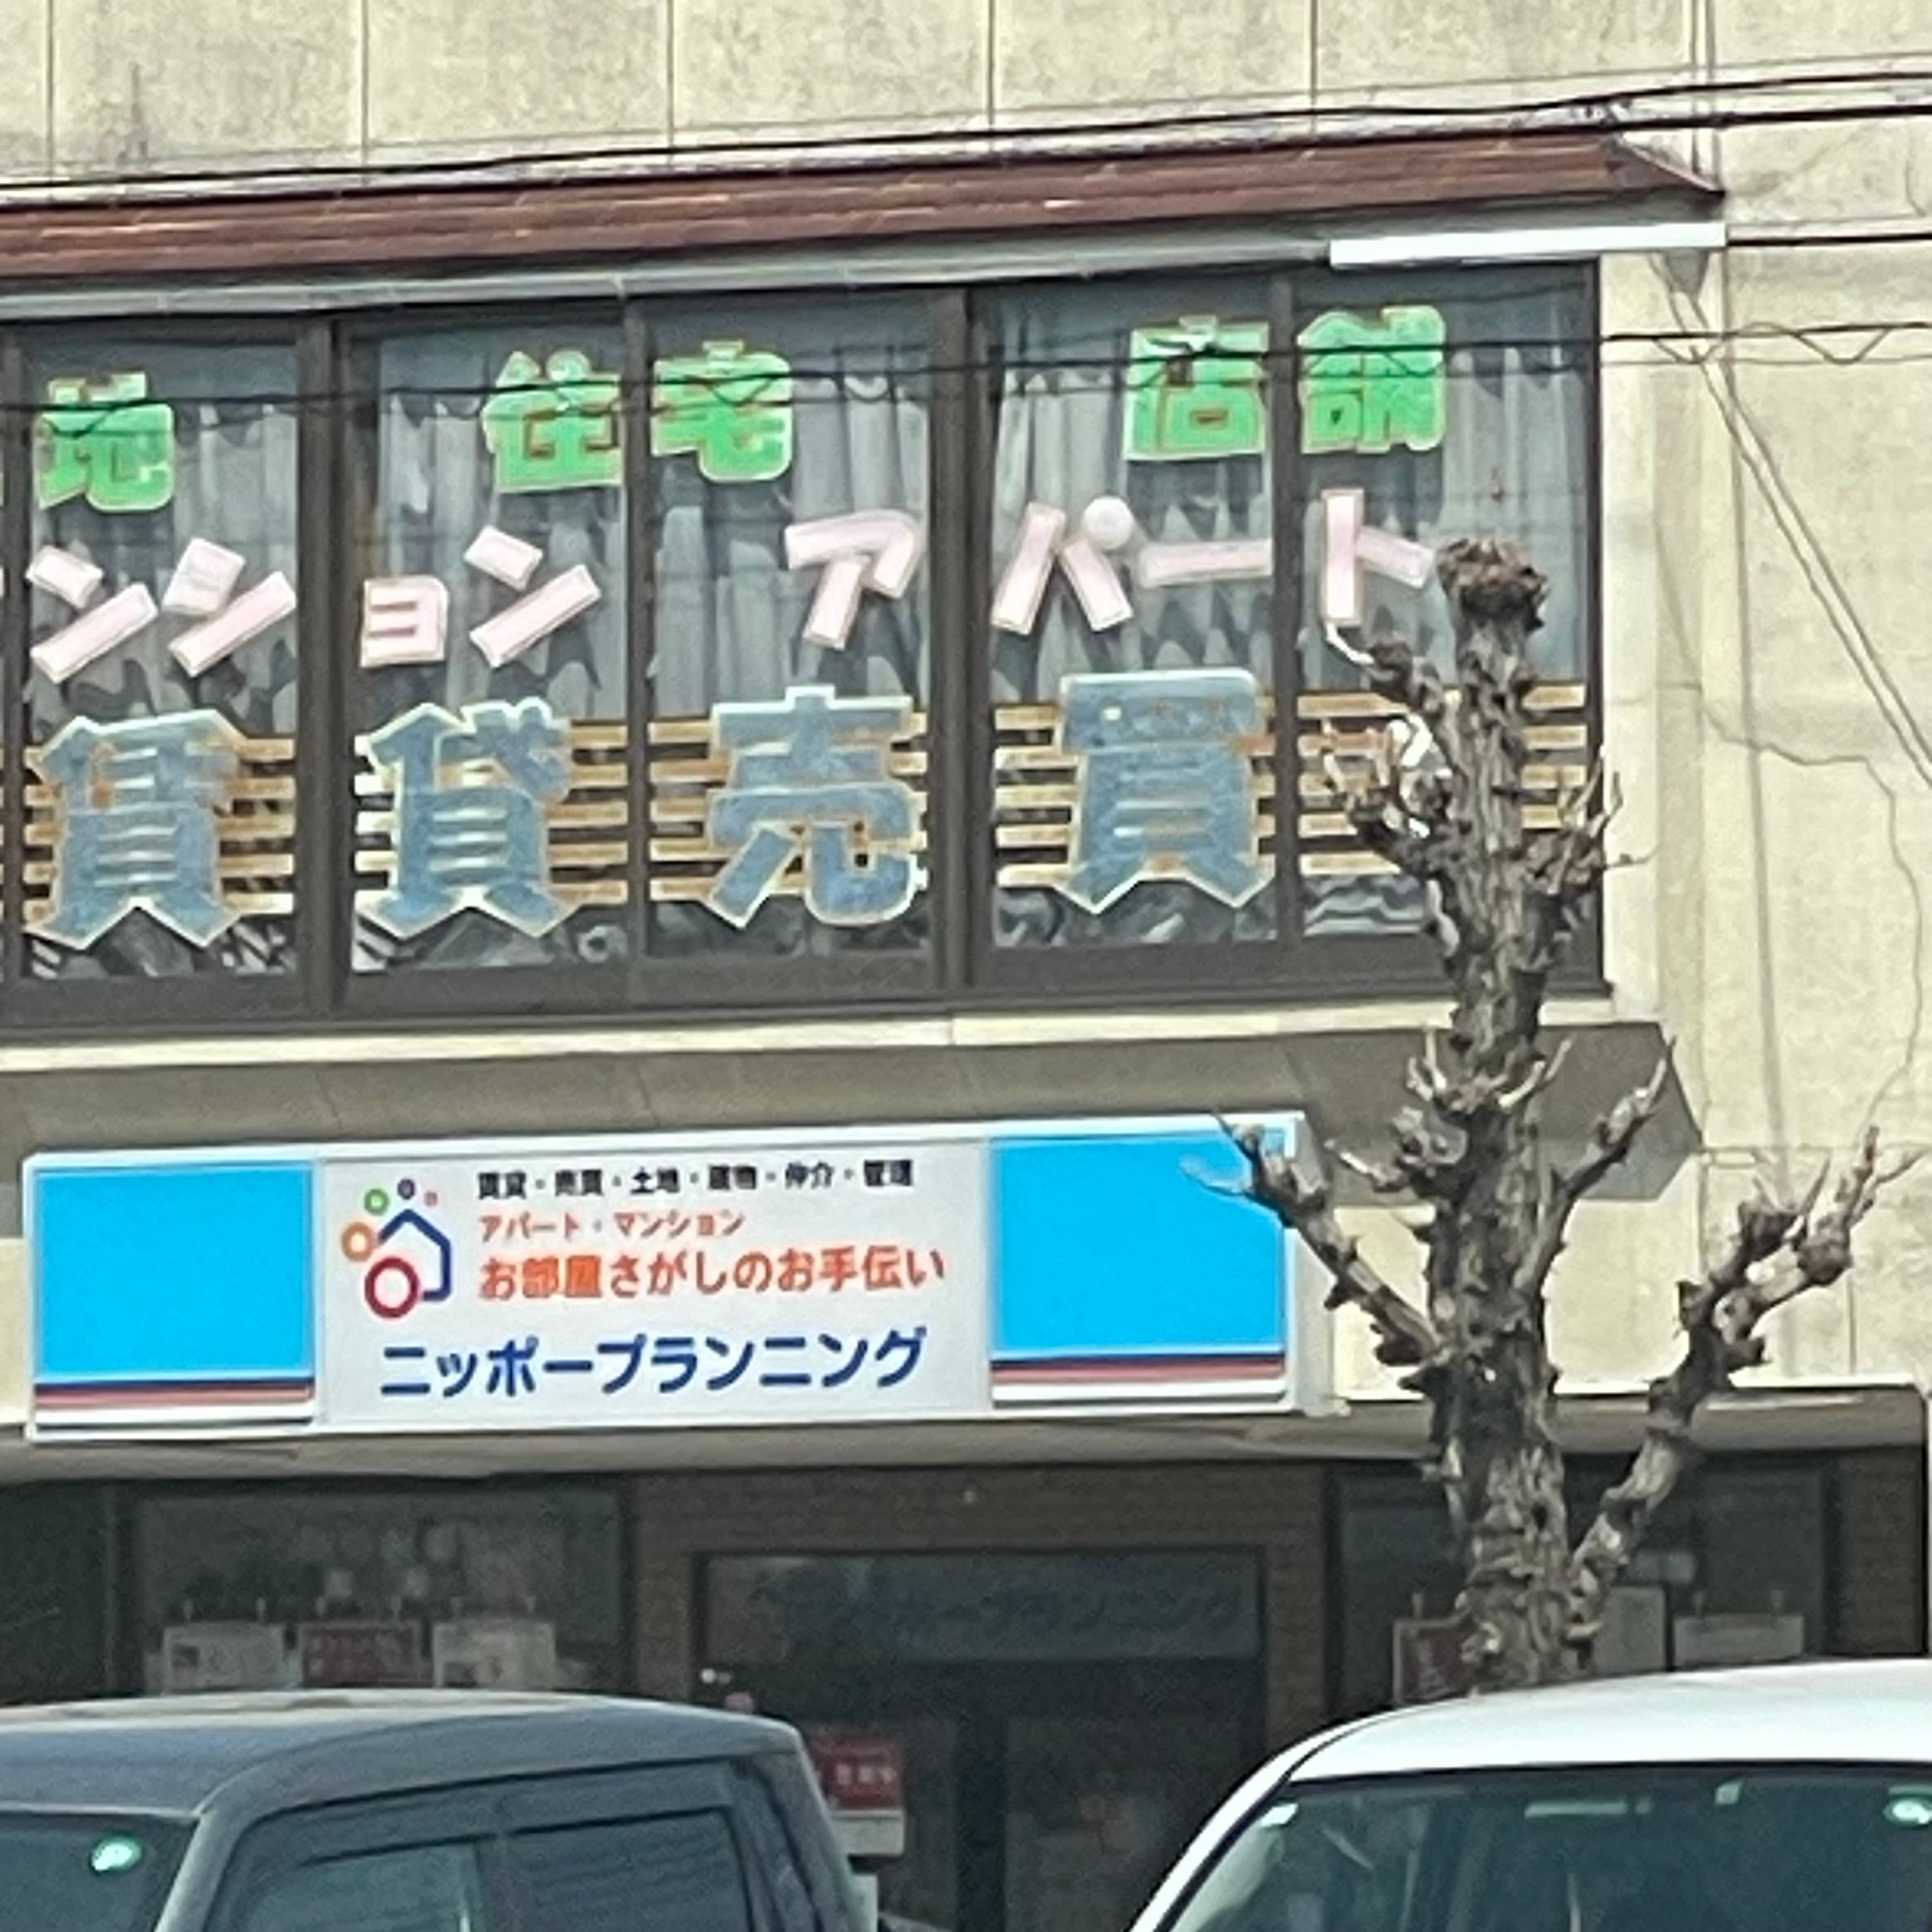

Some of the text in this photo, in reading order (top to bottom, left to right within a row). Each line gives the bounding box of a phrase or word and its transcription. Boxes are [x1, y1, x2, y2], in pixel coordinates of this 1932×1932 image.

[480, 339, 792, 494] 住宅
[1123, 305, 1446, 461] 店舗
[783, 487, 1438, 652] アパート
[480, 1244, 944, 1301] お部屋さがしのお手伝い
[381, 1325, 927, 1398] ニッポープランニング
